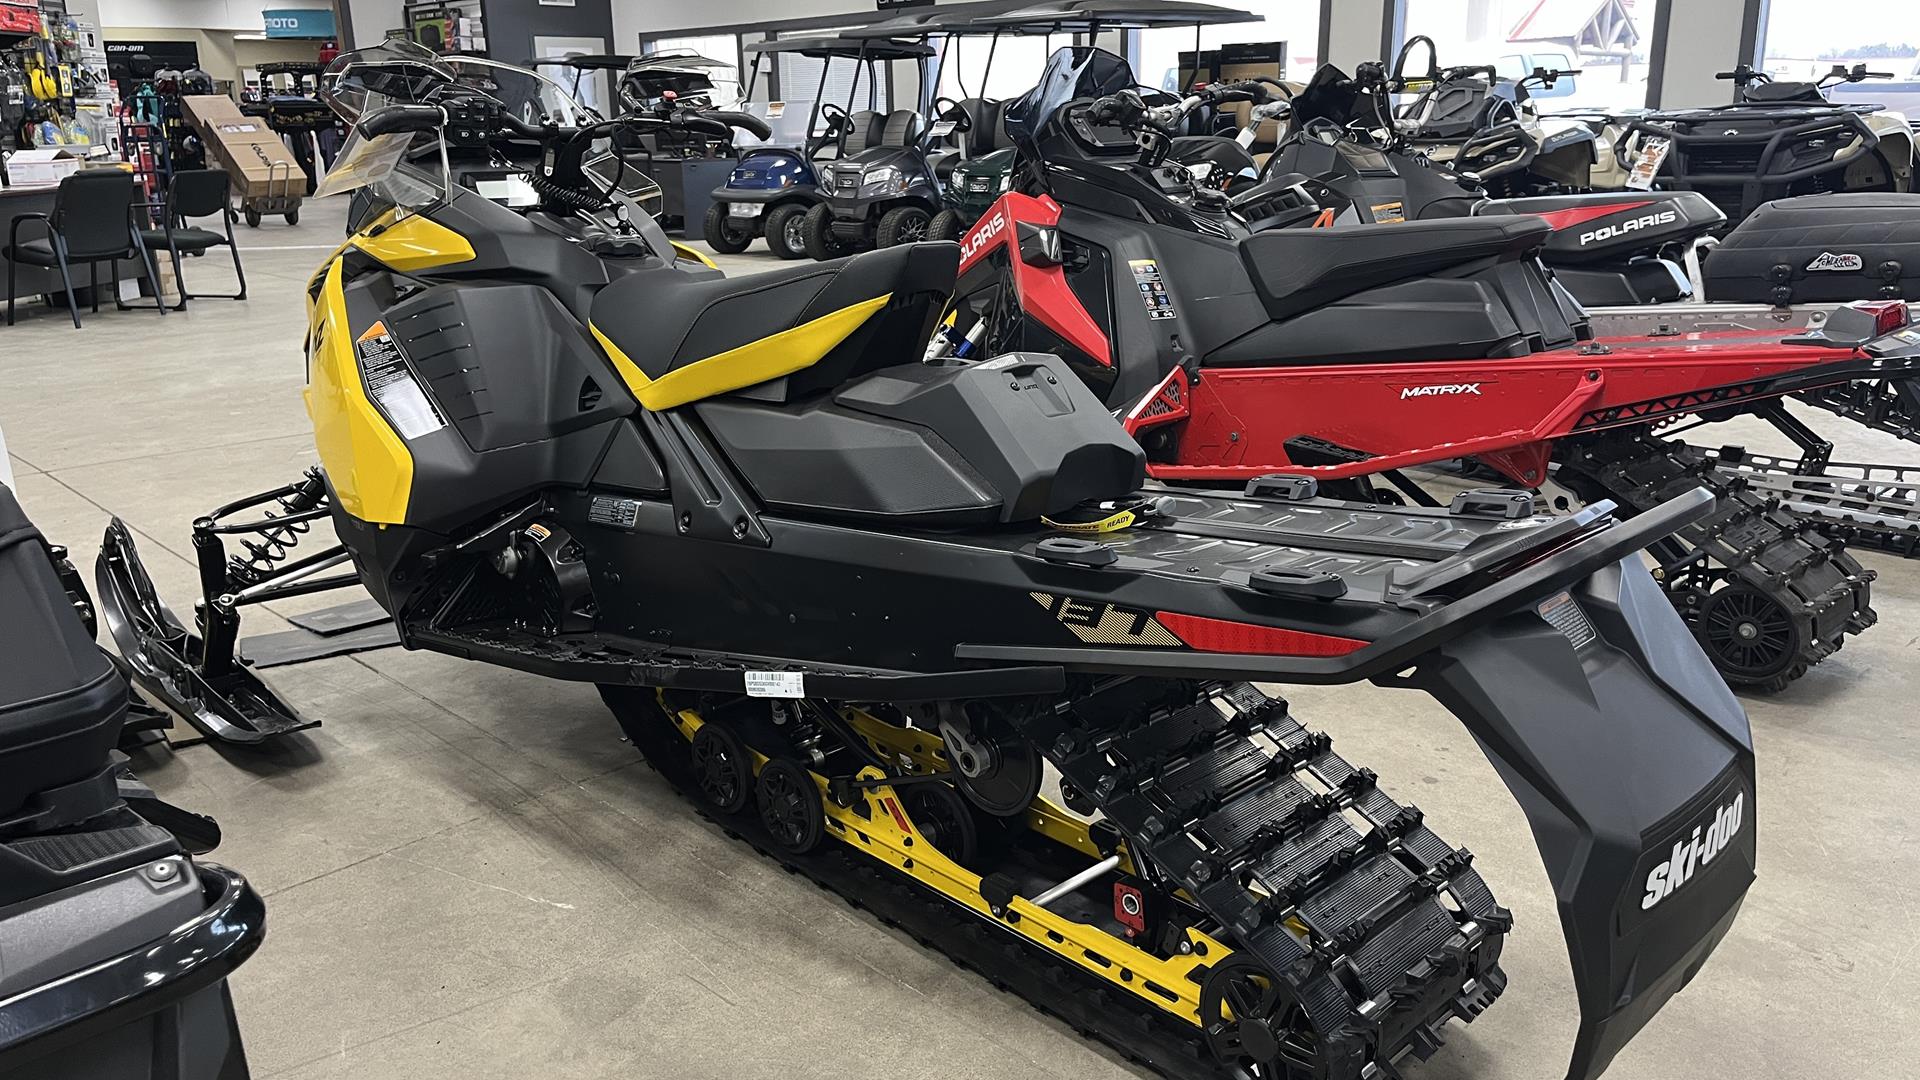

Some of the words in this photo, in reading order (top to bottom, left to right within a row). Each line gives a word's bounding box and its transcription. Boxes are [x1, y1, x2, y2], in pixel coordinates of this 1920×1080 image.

[1580, 211, 1676, 246] POLARIS
[1400, 383, 1481, 400] MATRYX
[1106, 515, 1130, 529] READY
[1641, 791, 1743, 910] ski-doo
